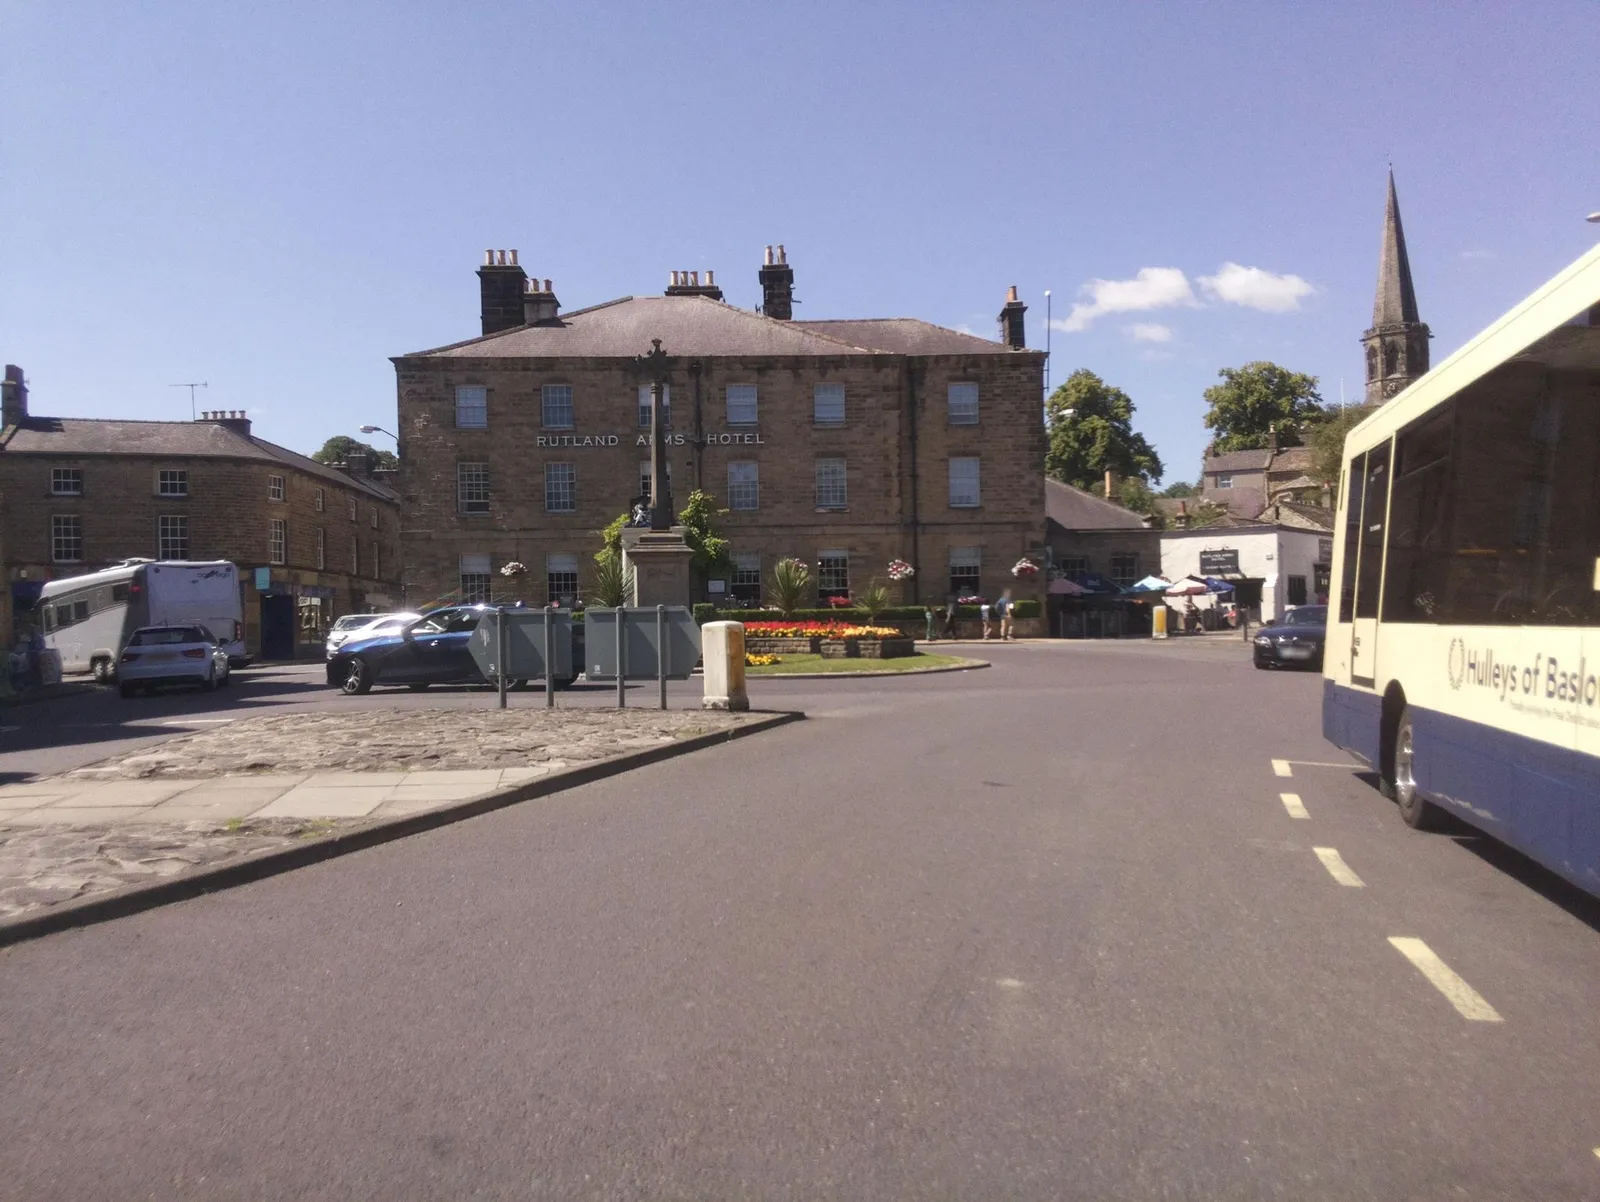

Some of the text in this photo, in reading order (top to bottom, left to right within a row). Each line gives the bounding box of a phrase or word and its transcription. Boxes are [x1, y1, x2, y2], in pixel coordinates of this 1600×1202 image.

[536, 435, 619, 447] RUTLAND
[707, 433, 765, 445] HOTEL
[1466, 648, 1600, 706] Hulleys of Baslo
